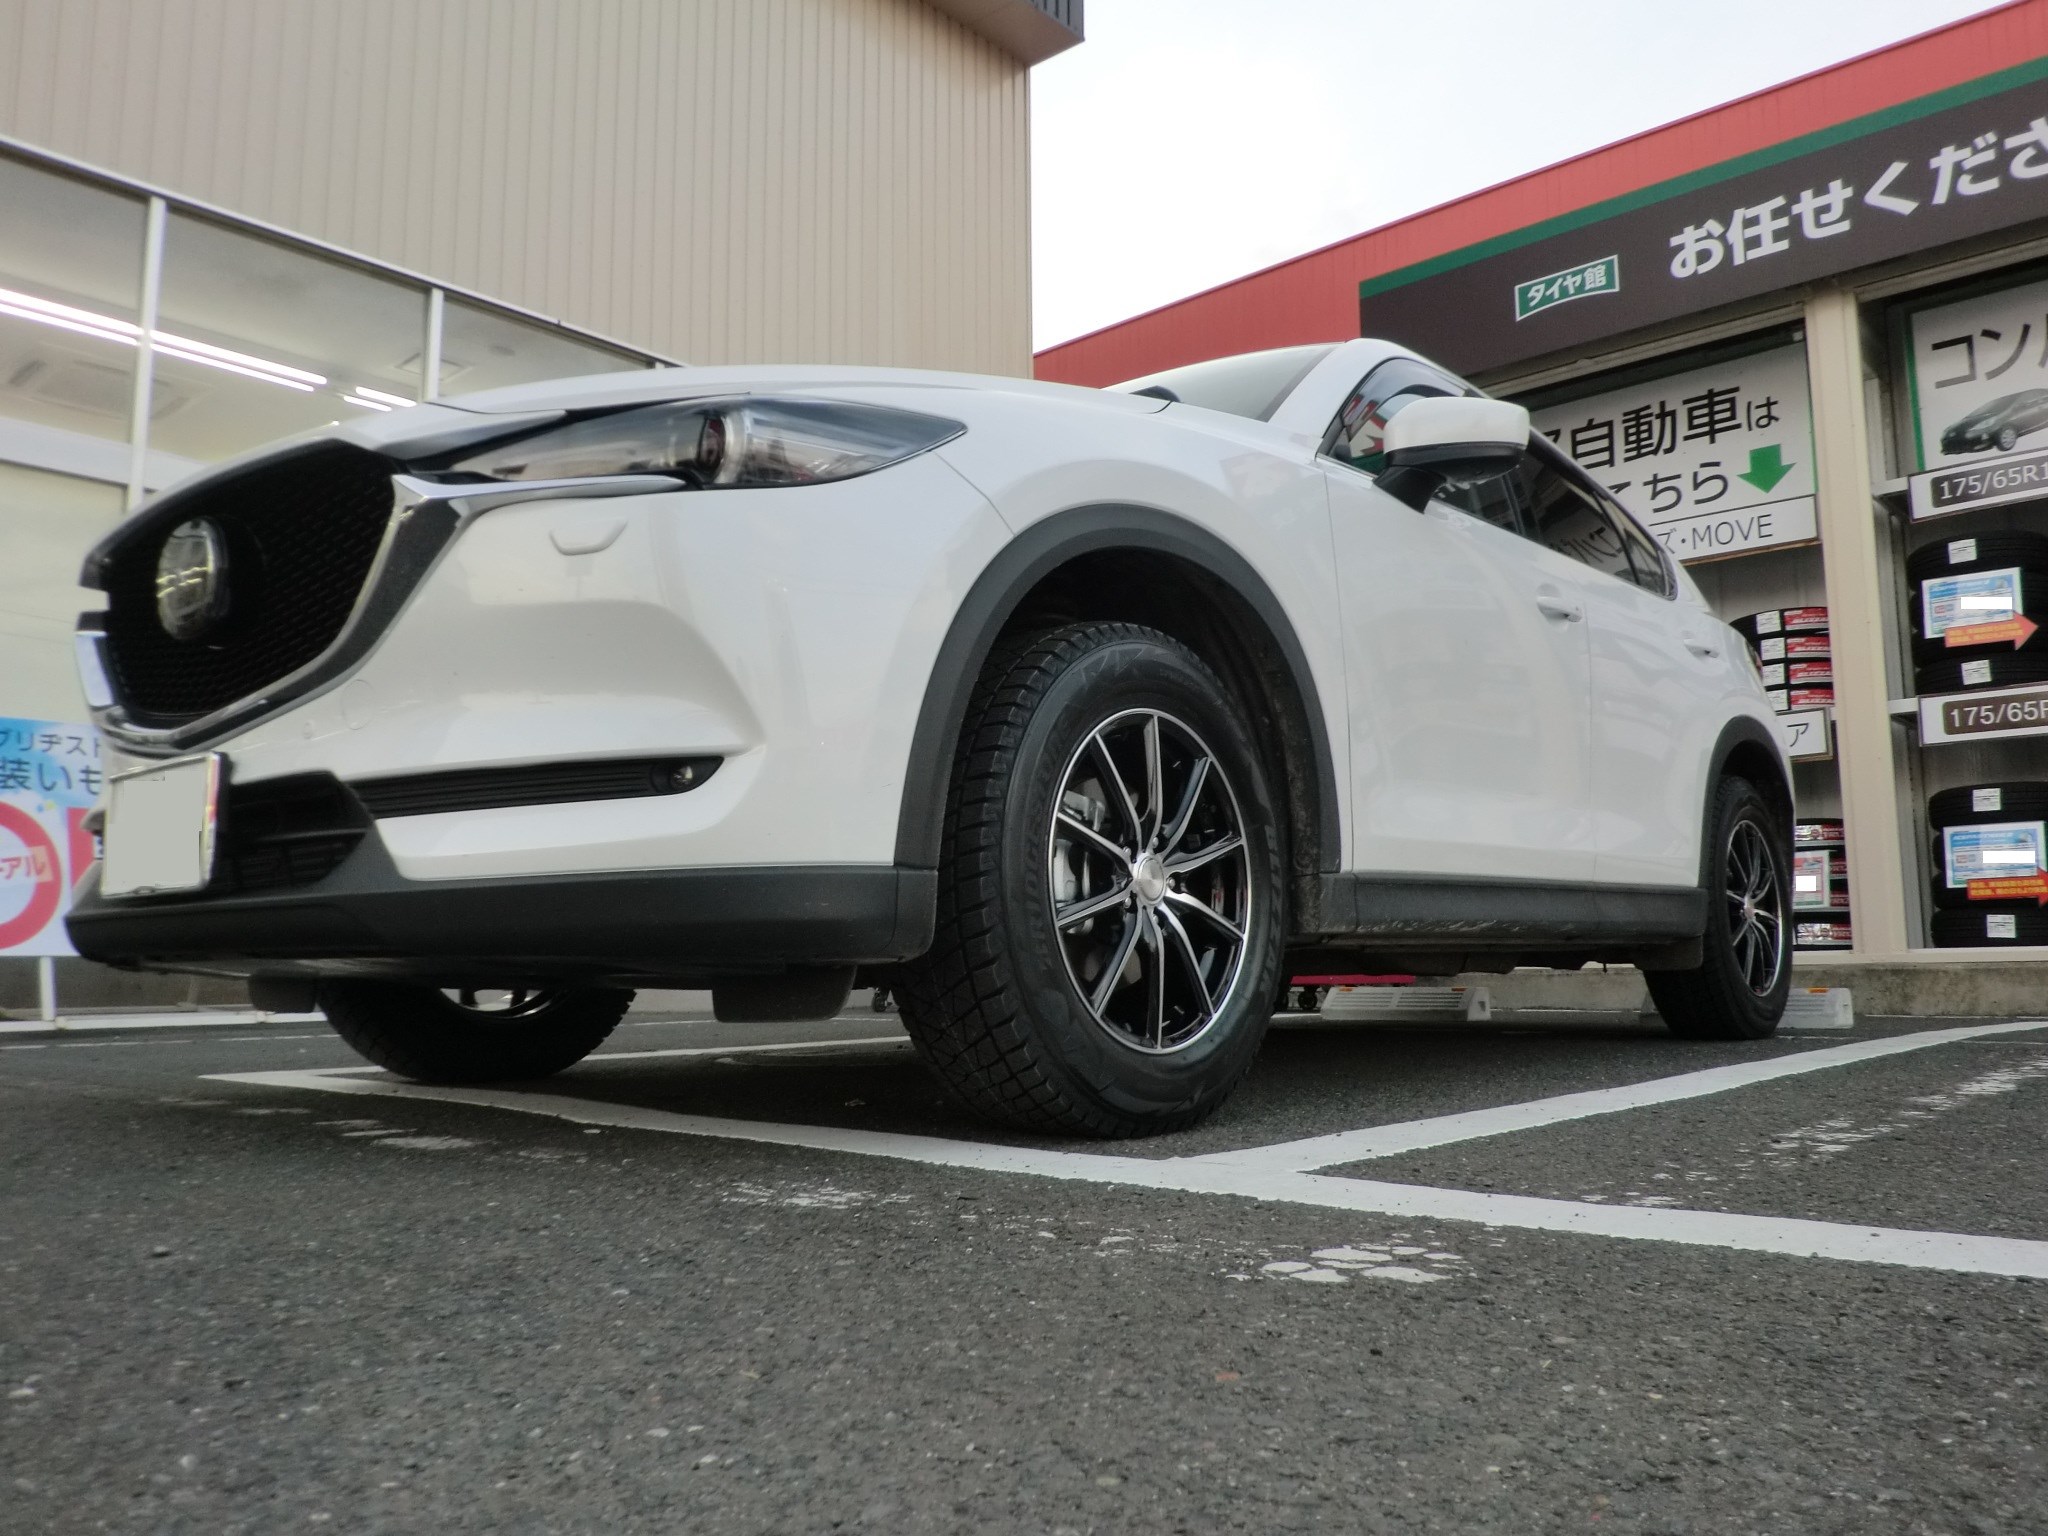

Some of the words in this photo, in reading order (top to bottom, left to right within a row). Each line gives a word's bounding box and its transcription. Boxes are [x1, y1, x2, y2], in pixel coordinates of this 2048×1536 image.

[1669, 117, 2048, 278] お任せくださ
[1527, 264, 1607, 307] タイヤ館
[1932, 313, 2048, 389] コン
